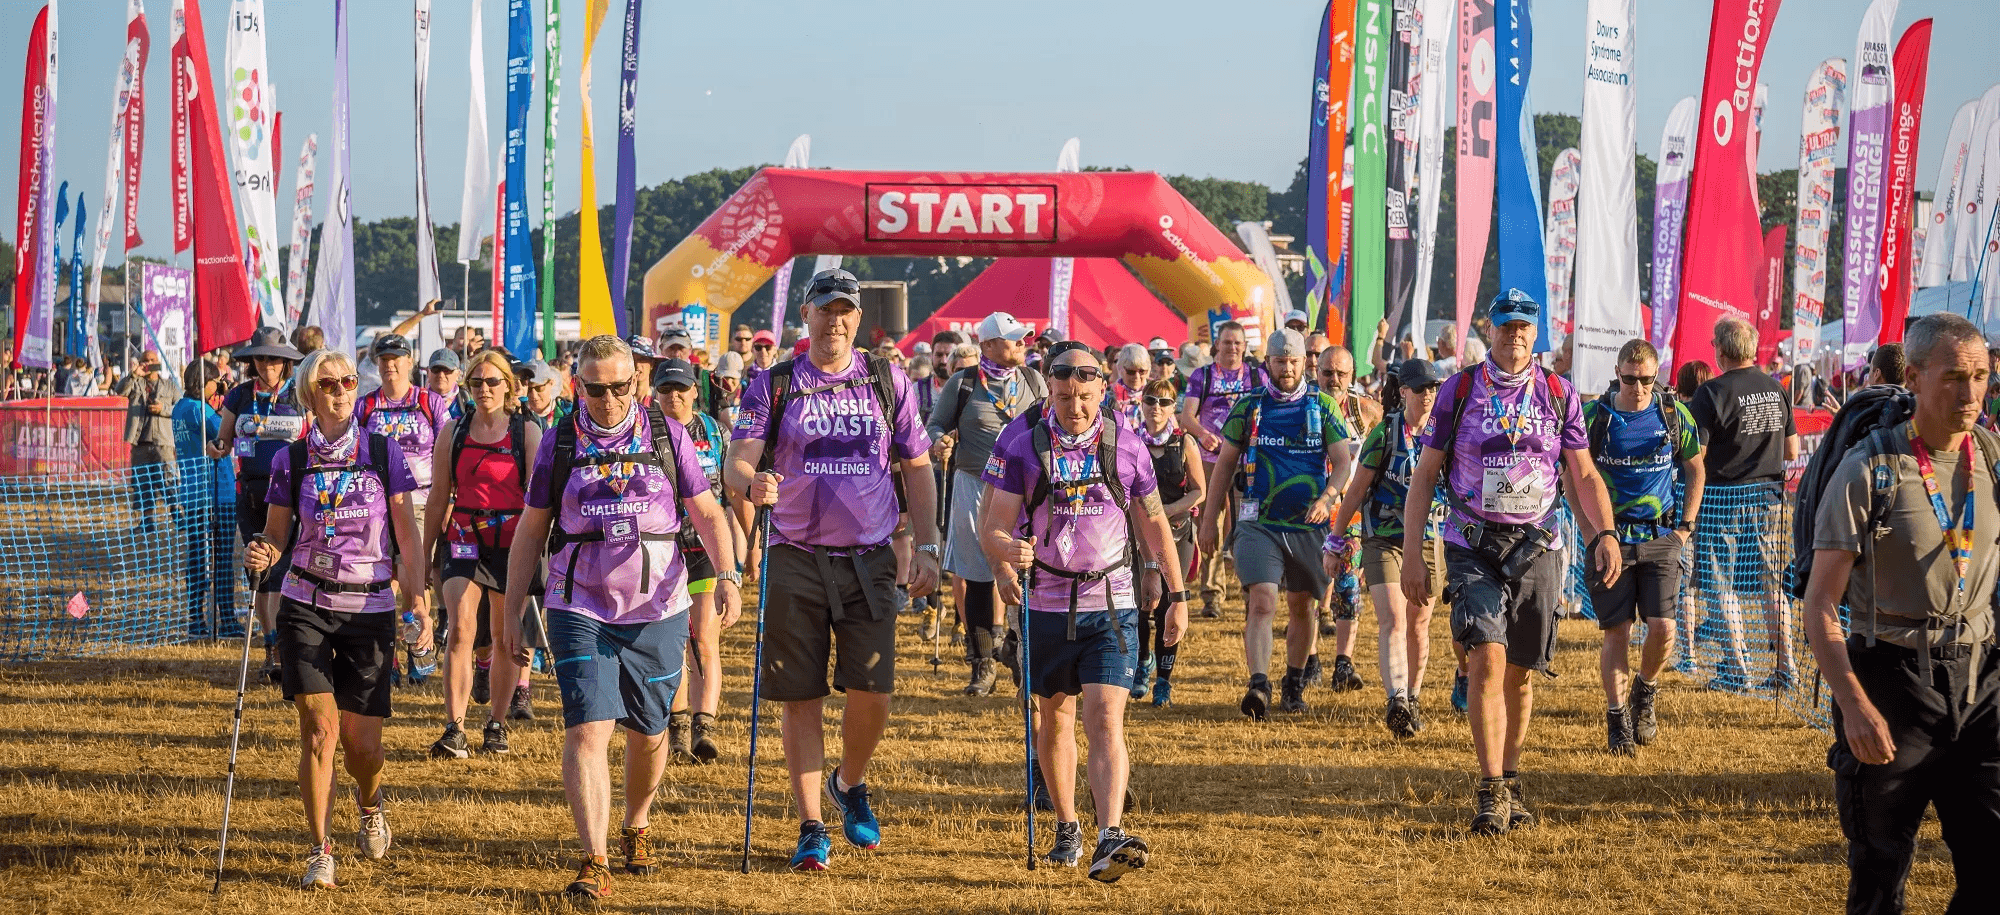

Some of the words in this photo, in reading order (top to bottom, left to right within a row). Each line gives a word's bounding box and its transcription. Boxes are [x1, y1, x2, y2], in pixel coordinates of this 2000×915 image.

[1587, 64, 1628, 86] Association
[1591, 40, 1621, 61] Syndrome
[1363, 2, 1380, 155] NSPCC
[1460, 62, 1469, 156] breast
[1807, 130, 1838, 153] ULTRA
[22, 84, 46, 253] actionchallenge
[1854, 131, 1869, 209] COAST
[1886, 102, 1914, 269] actionchallenge
[126, 184, 137, 238] WALK
[176, 192, 187, 241] WALK
[877, 191, 1047, 234] START
[1658, 198, 1671, 255] COAST
[1864, 133, 1884, 276] CHALLENGE
[706, 218, 768, 276] actionchallenge
[1162, 229, 1225, 287] actionchallenge
[1846, 215, 1863, 325] JURASSIC
[1654, 257, 1666, 339] JURASSIC
[803, 398, 873, 416] JURASSIC
[1738, 391, 1780, 407] MARILLION
[803, 415, 874, 437] COAST
[804, 461, 870, 475] CHALLENGE
[1497, 481, 1531, 494] 260
[314, 507, 369, 521] CHLLENGE
[580, 501, 650, 517] CHALLENGE
